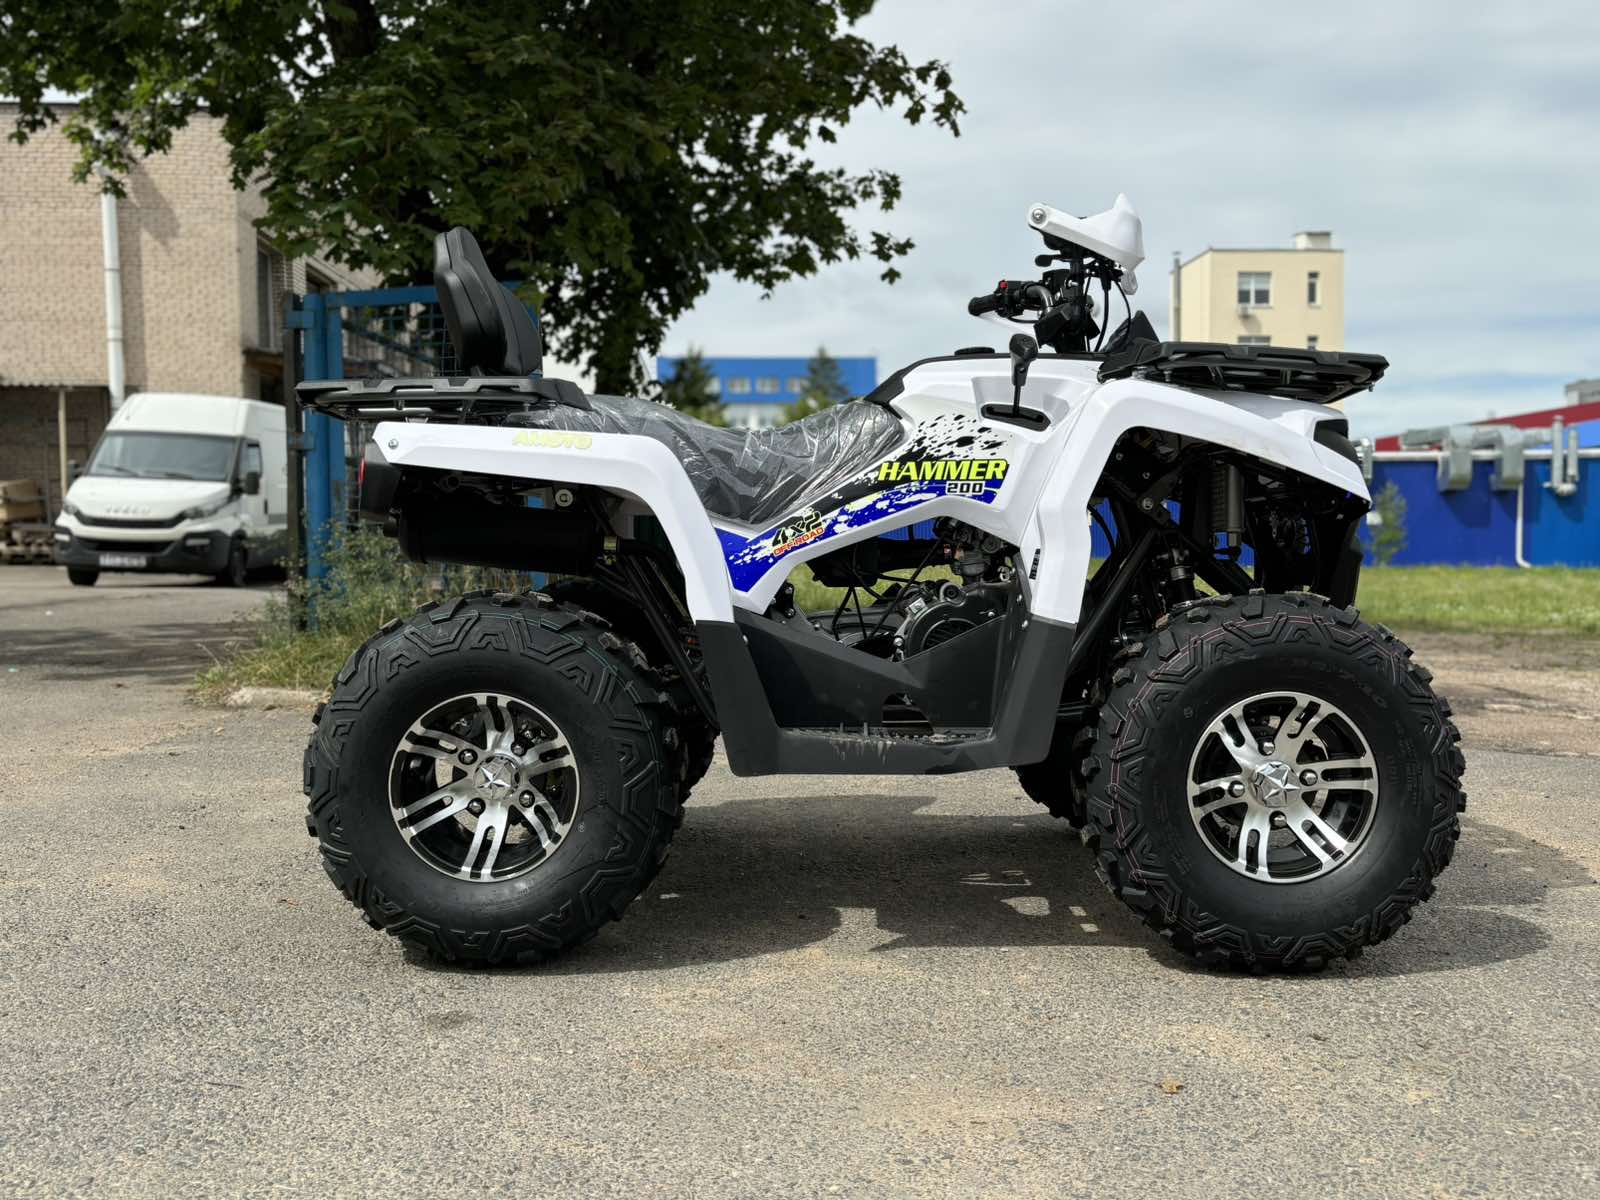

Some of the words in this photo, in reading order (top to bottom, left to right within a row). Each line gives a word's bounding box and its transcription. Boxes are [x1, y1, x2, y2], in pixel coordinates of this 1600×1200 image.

[512, 431, 592, 449] AMOTO
[878, 460, 1007, 481] HAMMER
[947, 482, 984, 494] 200
